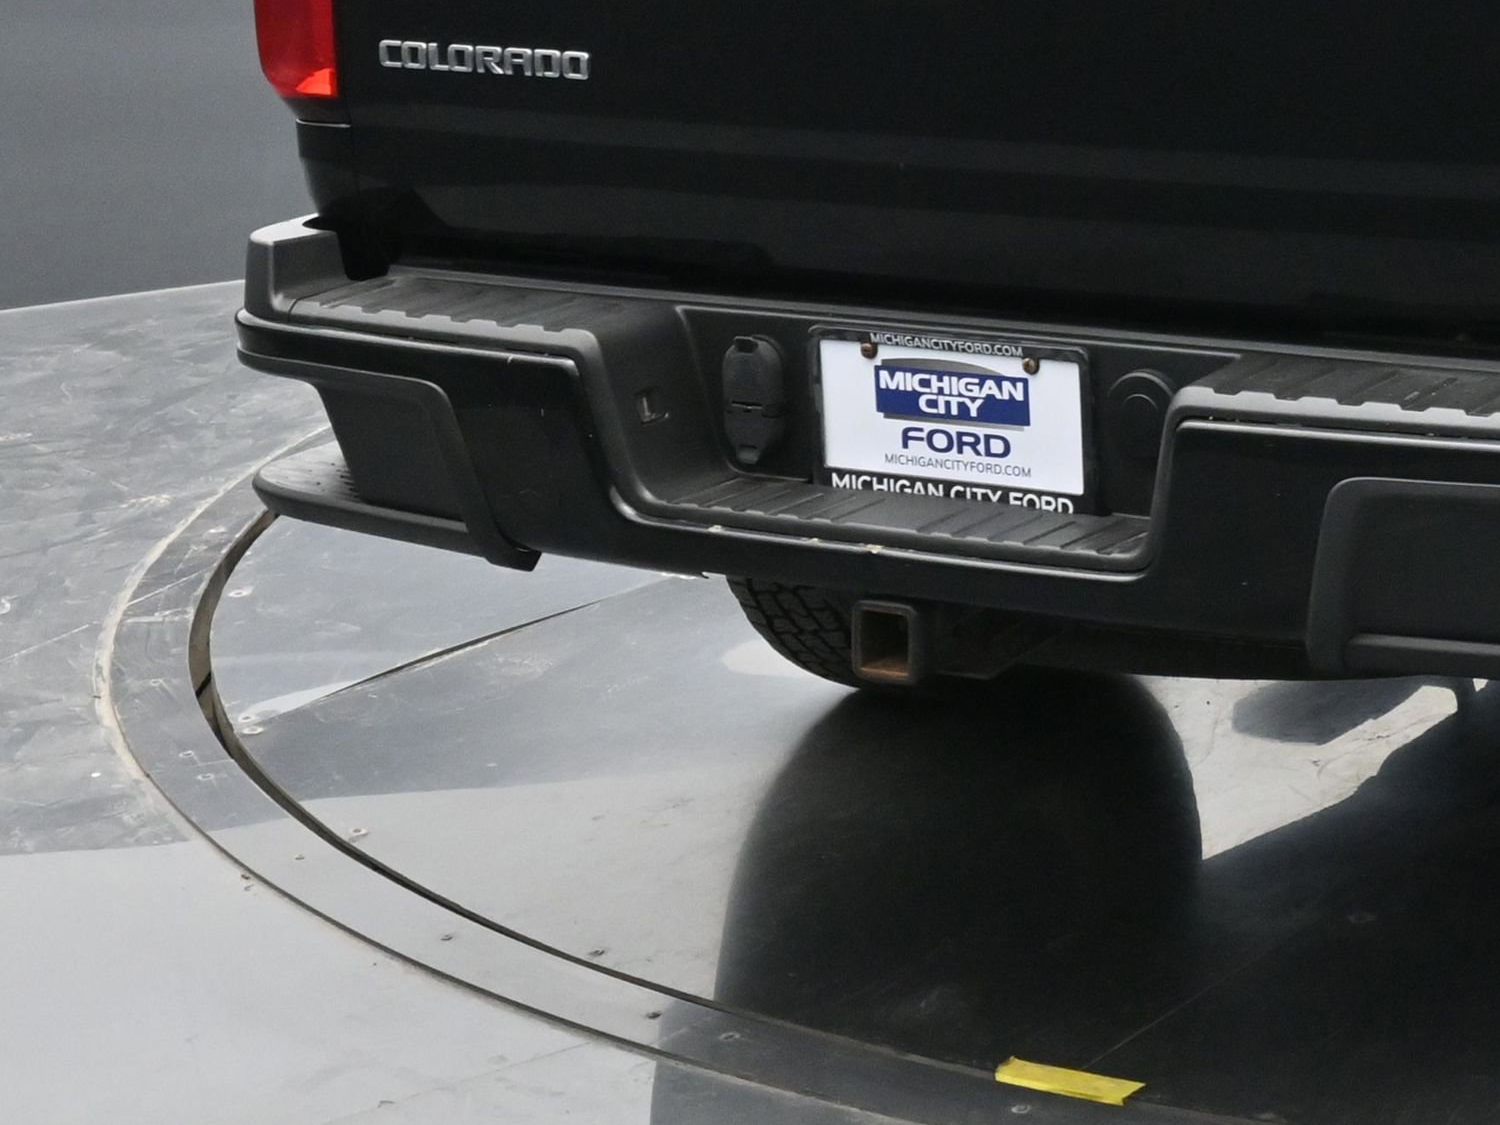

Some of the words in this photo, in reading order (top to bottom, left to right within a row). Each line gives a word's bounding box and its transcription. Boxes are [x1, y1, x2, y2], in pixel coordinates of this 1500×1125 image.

[379, 39, 590, 81] COLORADO
[869, 332, 1024, 357] MICHIGANCITYFORD.COM
[878, 369, 1025, 402] MICHIGAN
[918, 394, 985, 418] CITY
[901, 426, 1012, 459] FORD
[884, 453, 1032, 478] MICHIGANCITYFORD.COM
[831, 472, 945, 497] MICHIGAN
[950, 485, 1003, 503] CITY
[1008, 491, 1074, 515] FORD
